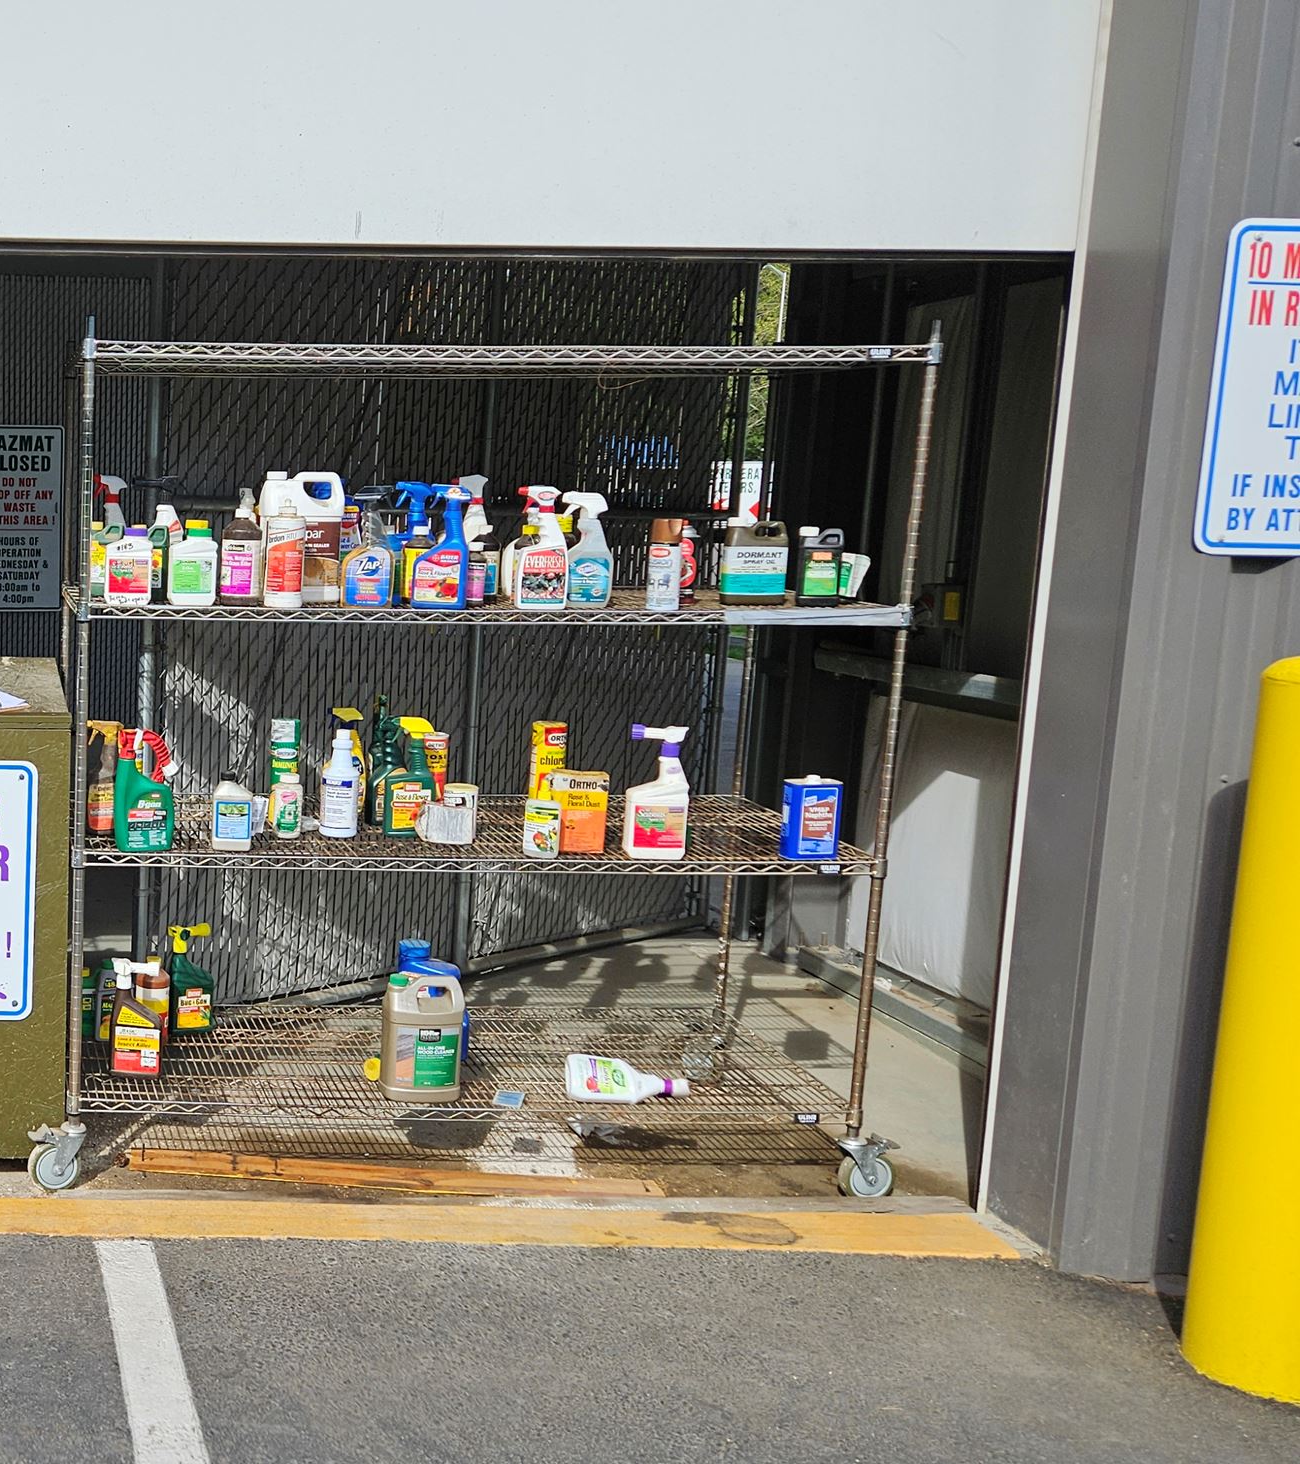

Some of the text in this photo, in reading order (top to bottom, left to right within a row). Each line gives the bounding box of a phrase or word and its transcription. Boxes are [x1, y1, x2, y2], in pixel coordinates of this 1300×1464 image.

[1249, 242, 1271, 279] 10
[1249, 290, 1300, 326] IN R
[1289, 339, 1300, 364] I
[2, 478, 37, 487] DO NOT
[1231, 474, 1252, 498] IF
[14, 490, 30, 500] OFF
[35, 490, 54, 500] ANY
[4, 502, 36, 512] WASTE
[23, 516, 48, 525] AREA
[1227, 507, 1256, 532] BY
[29, 537, 39, 546] OF
[42, 560, 48, 568] &
[526, 556, 564, 568] EVERFRESH
[32, 583, 40, 592] to
[2, 594, 34, 604] 4:00pm
[569, 779, 597, 789] ORTHO
